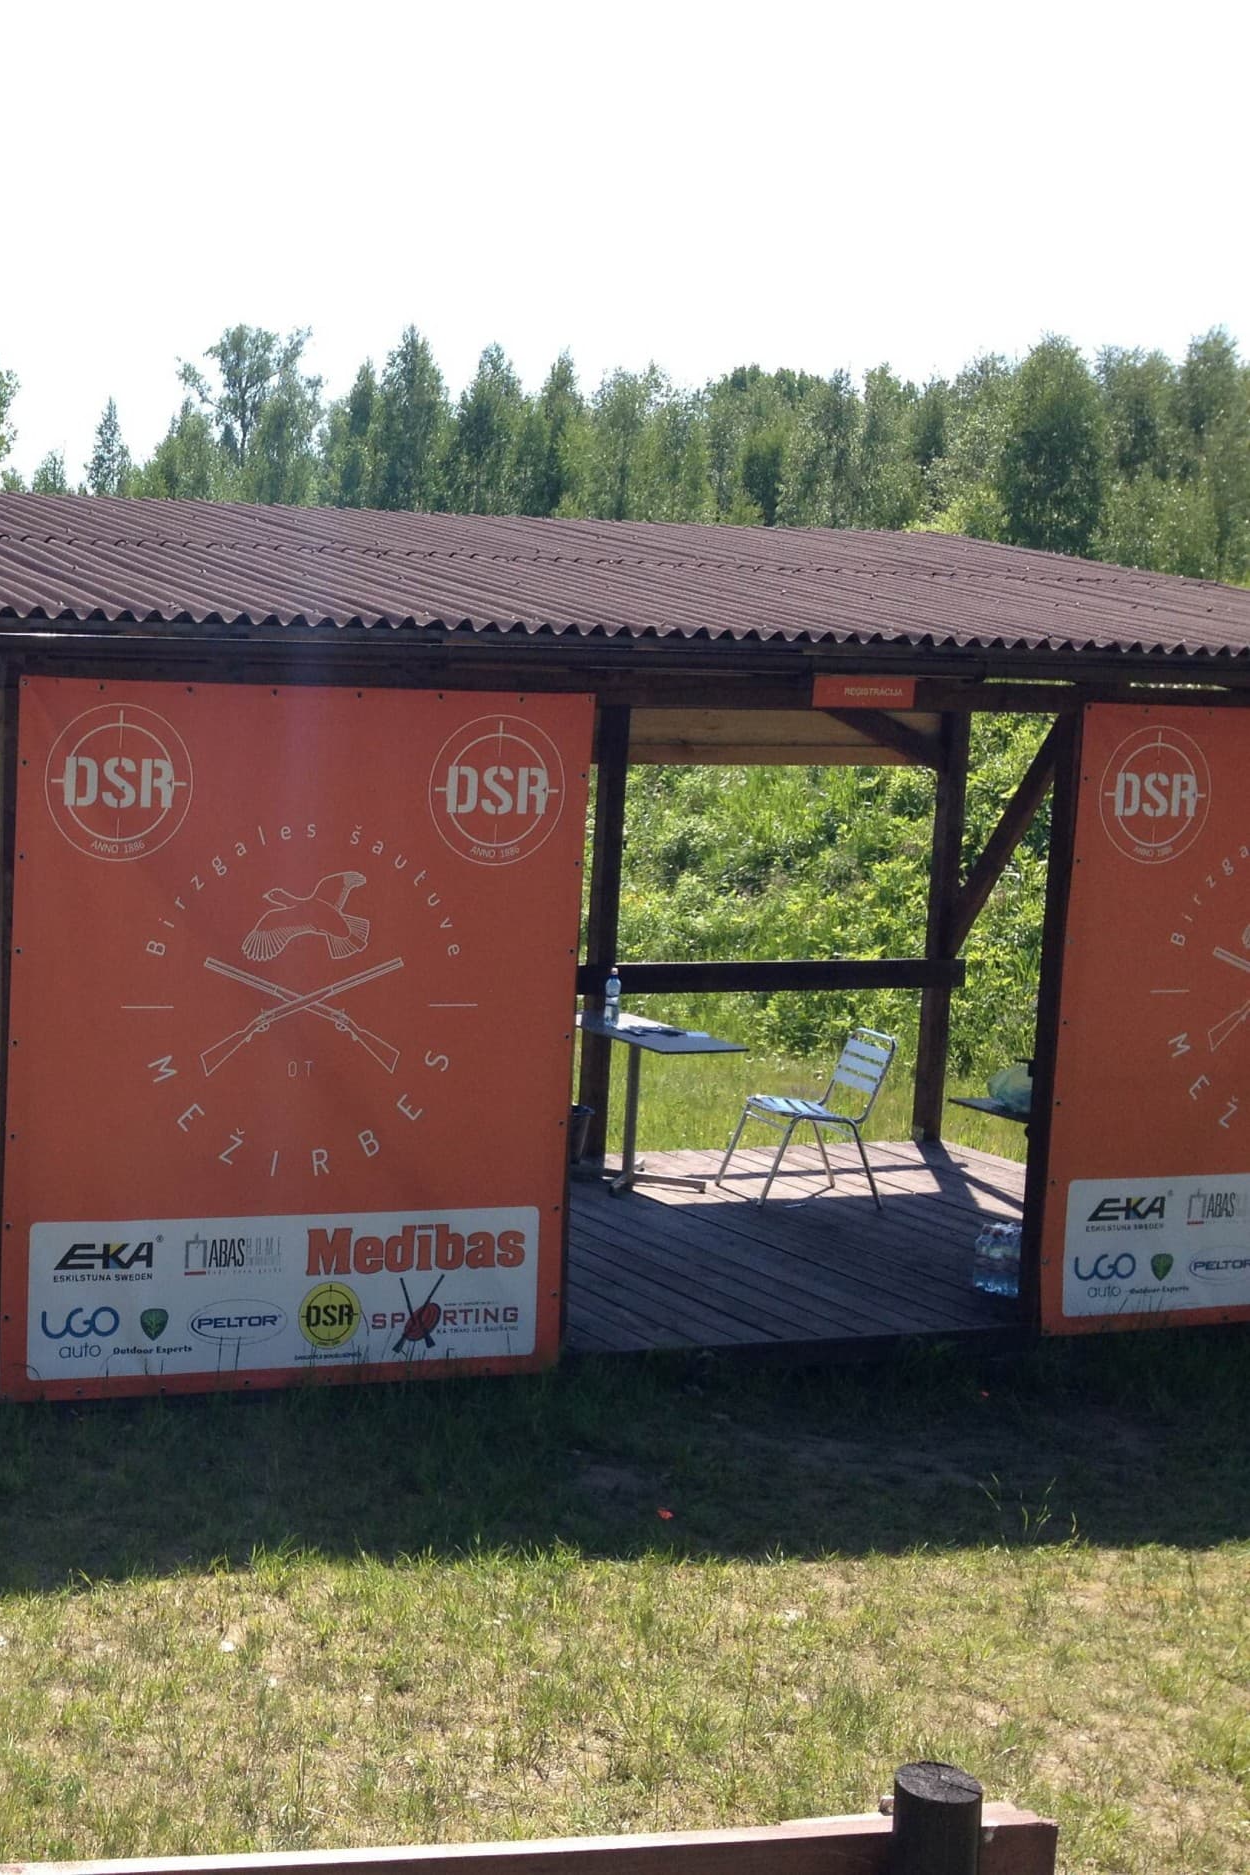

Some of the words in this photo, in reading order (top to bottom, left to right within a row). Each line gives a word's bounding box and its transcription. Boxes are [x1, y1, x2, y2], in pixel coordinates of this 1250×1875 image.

[63, 757, 174, 808] DSR
[445, 766, 549, 814] DSR
[1114, 772, 1197, 817] DSR
[91, 840, 119, 853] ANNO
[1087, 1196, 1166, 1221] EKA
[54, 1241, 153, 1271] EKA
[306, 1224, 526, 1276] Medības
[53, 1274, 112, 1283] ESKILSTUNA
[114, 1272, 153, 1282] SWEDEN
[197, 1314, 277, 1329] PELTOR
[59, 1342, 101, 1359] auto
[156, 1345, 192, 1354] Experts
